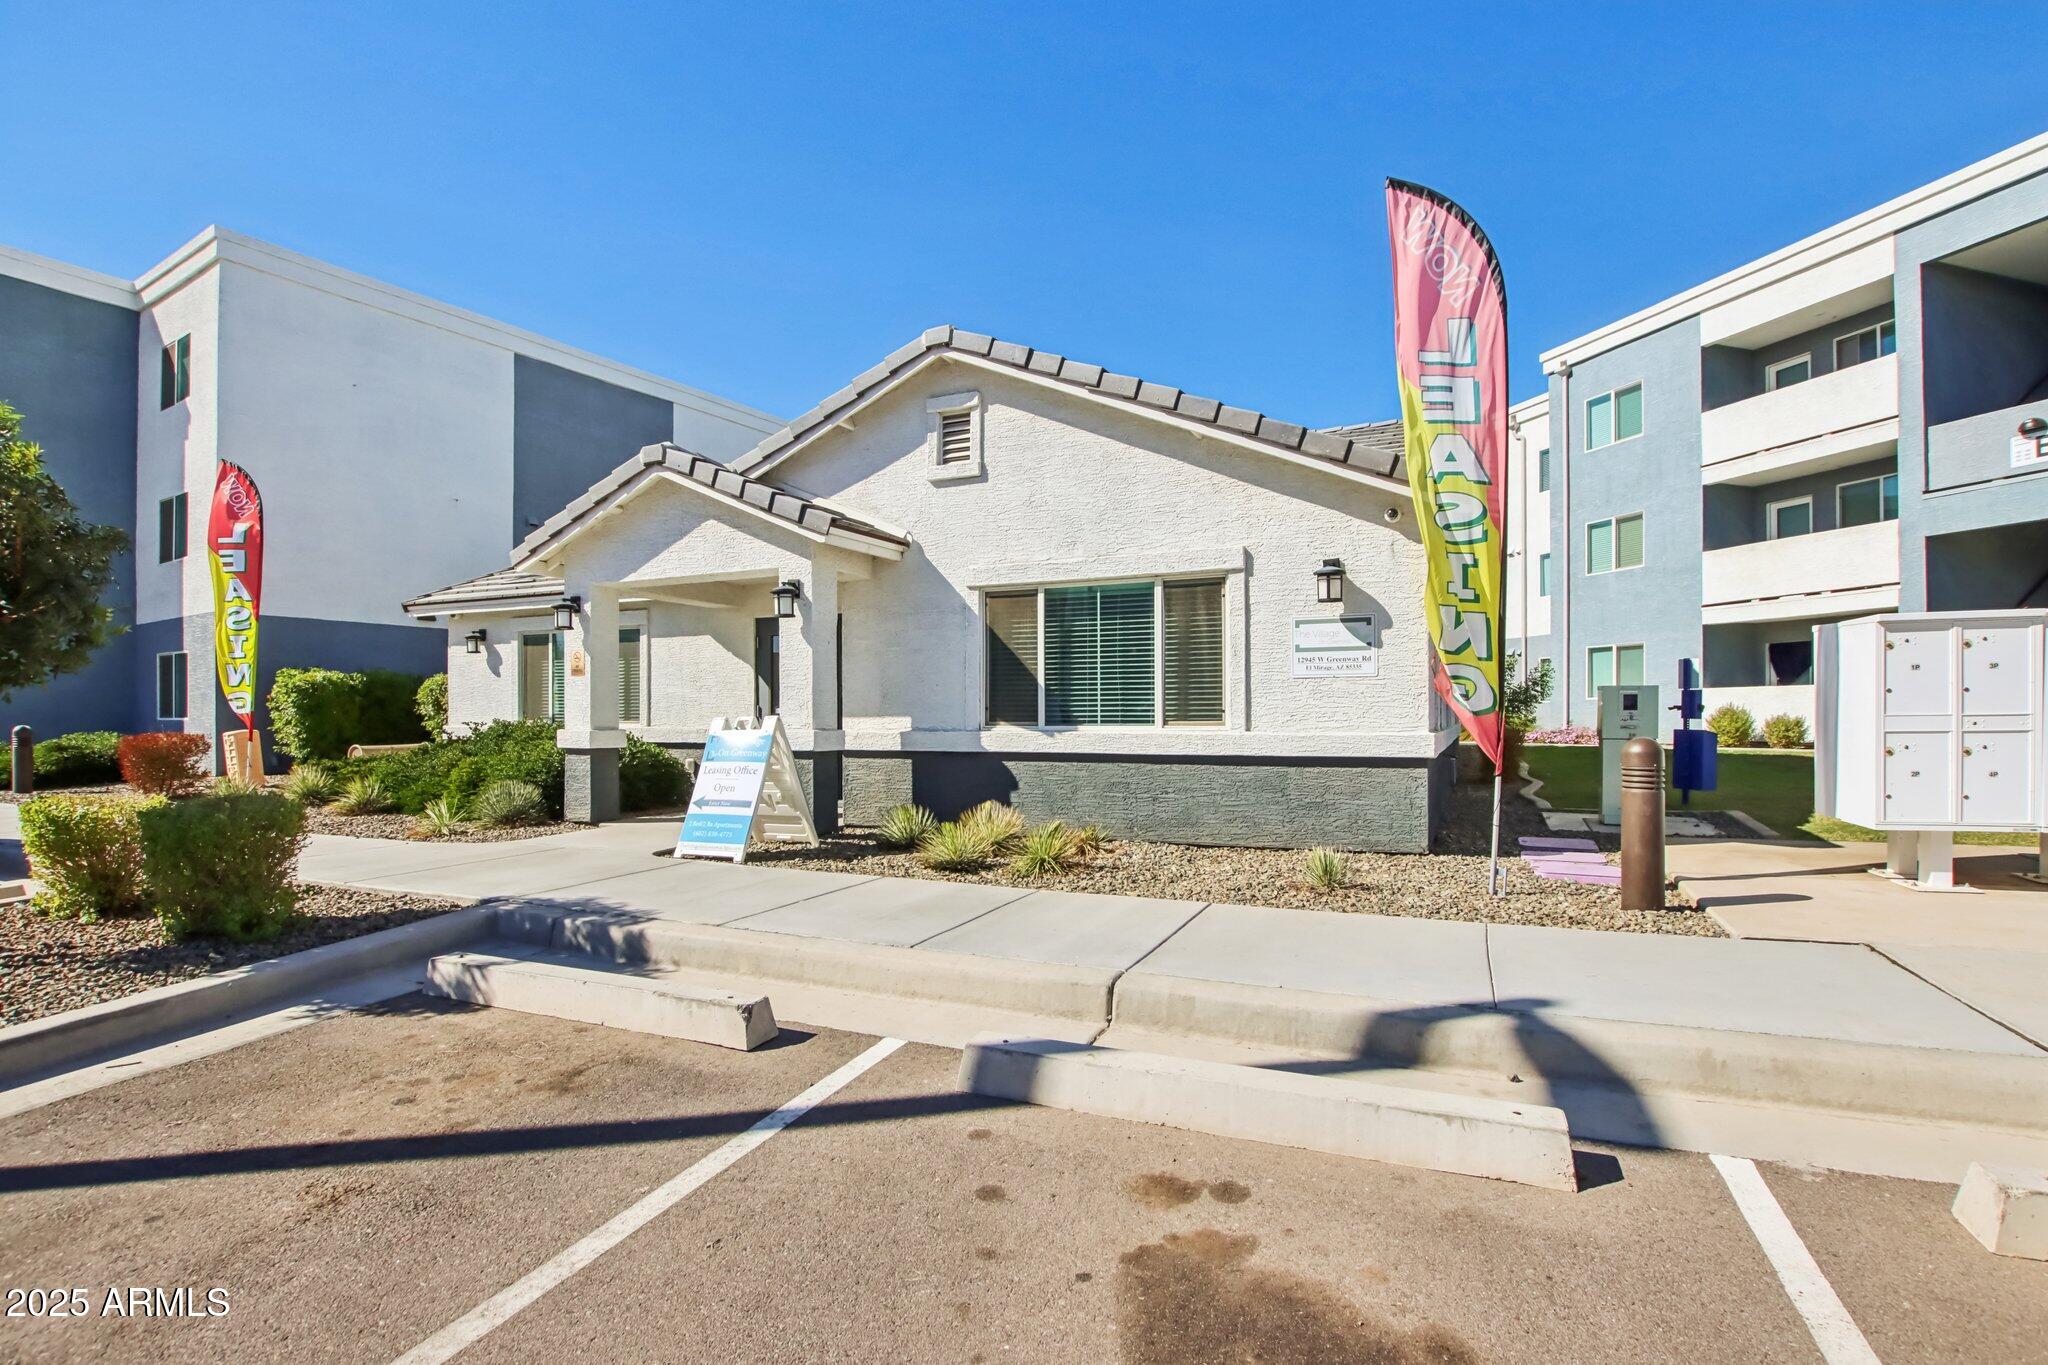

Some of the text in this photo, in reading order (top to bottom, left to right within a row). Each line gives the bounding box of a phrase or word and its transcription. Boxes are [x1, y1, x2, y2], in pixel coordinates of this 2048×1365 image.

[1326, 656, 1360, 664] Greenway
[703, 765, 759, 777] Leasing Office
[713, 782, 736, 794] Open
